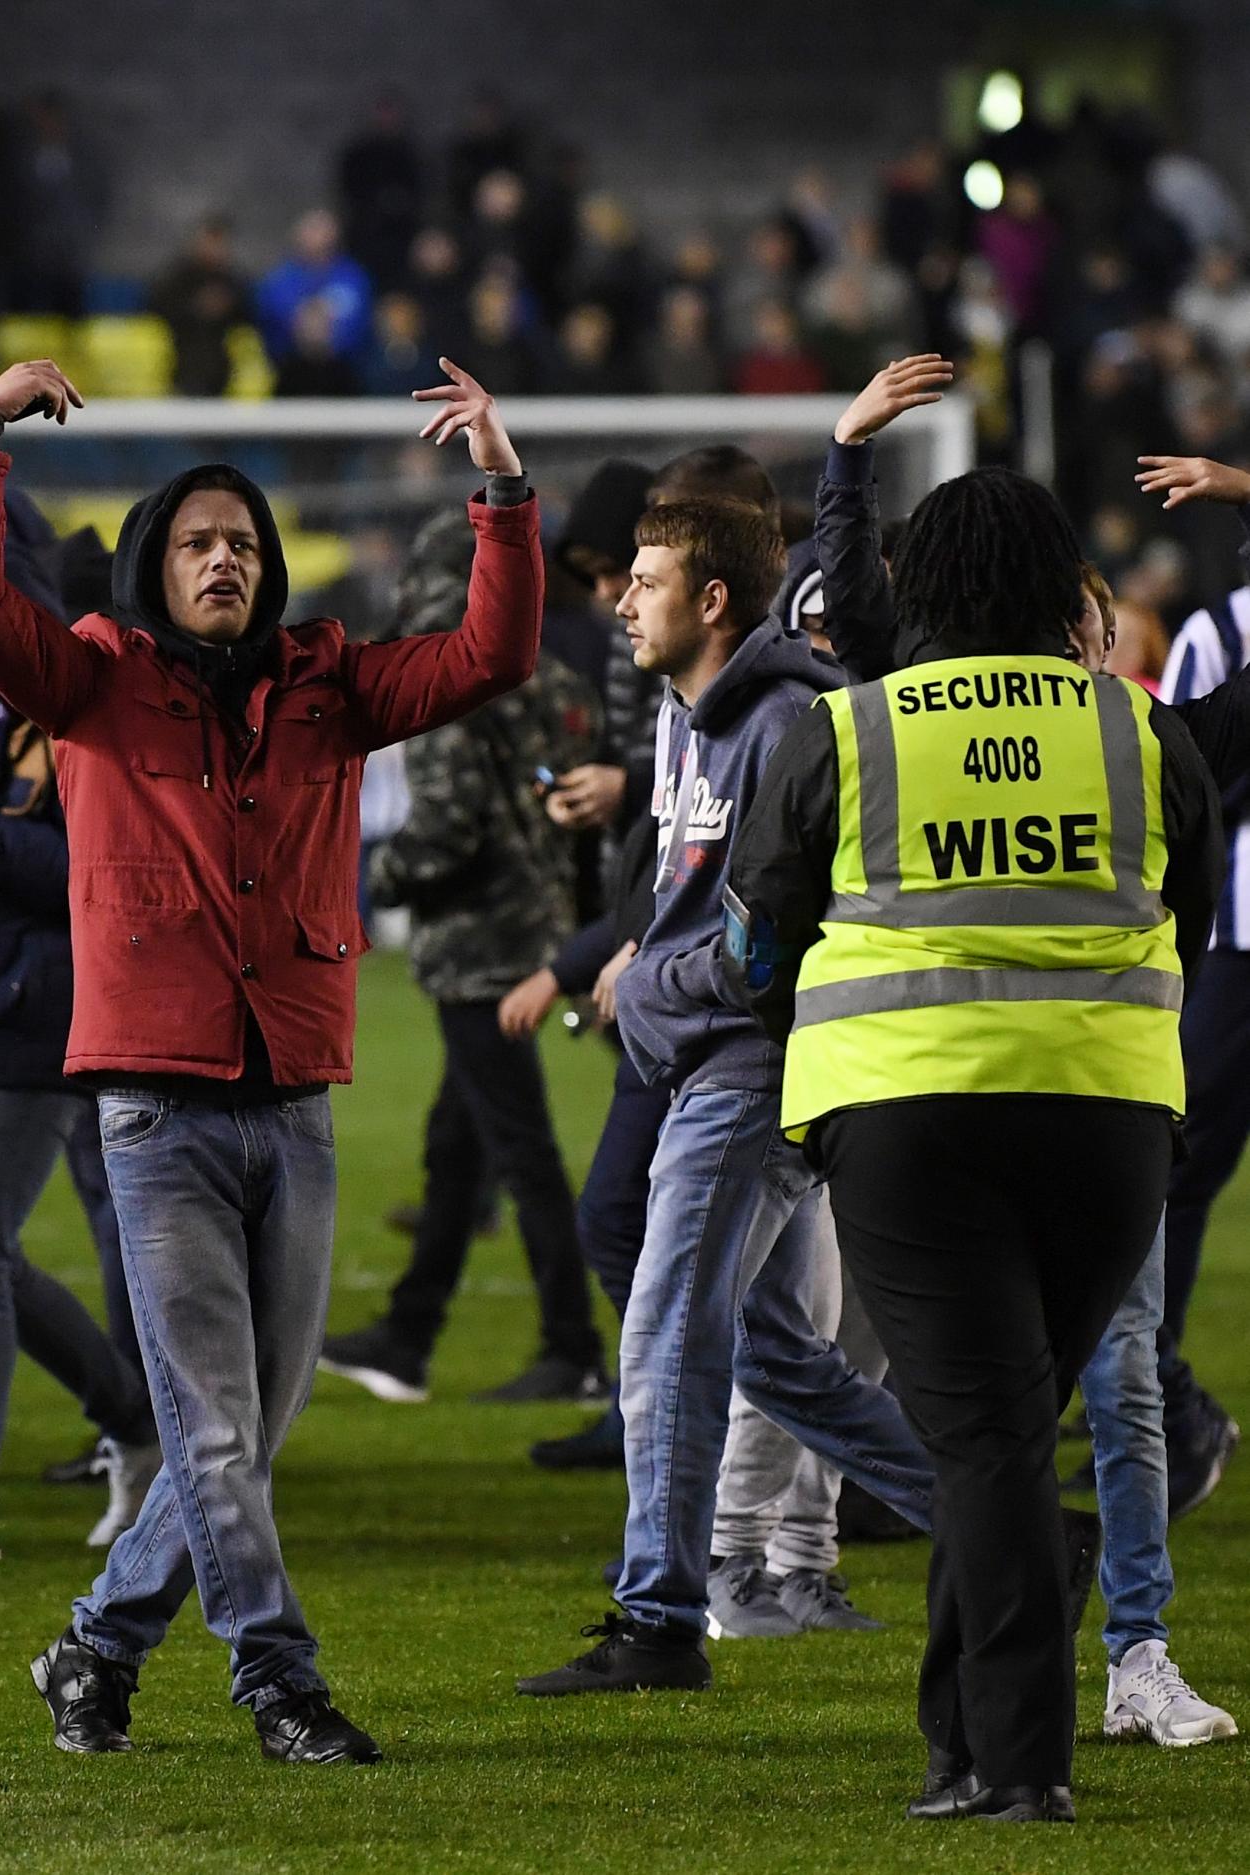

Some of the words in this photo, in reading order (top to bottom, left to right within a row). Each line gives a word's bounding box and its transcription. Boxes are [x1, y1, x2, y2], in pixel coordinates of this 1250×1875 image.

[897, 672, 1089, 715] SECURITY
[964, 736, 1041, 783] 4008
[923, 814, 1099, 880] WISE
